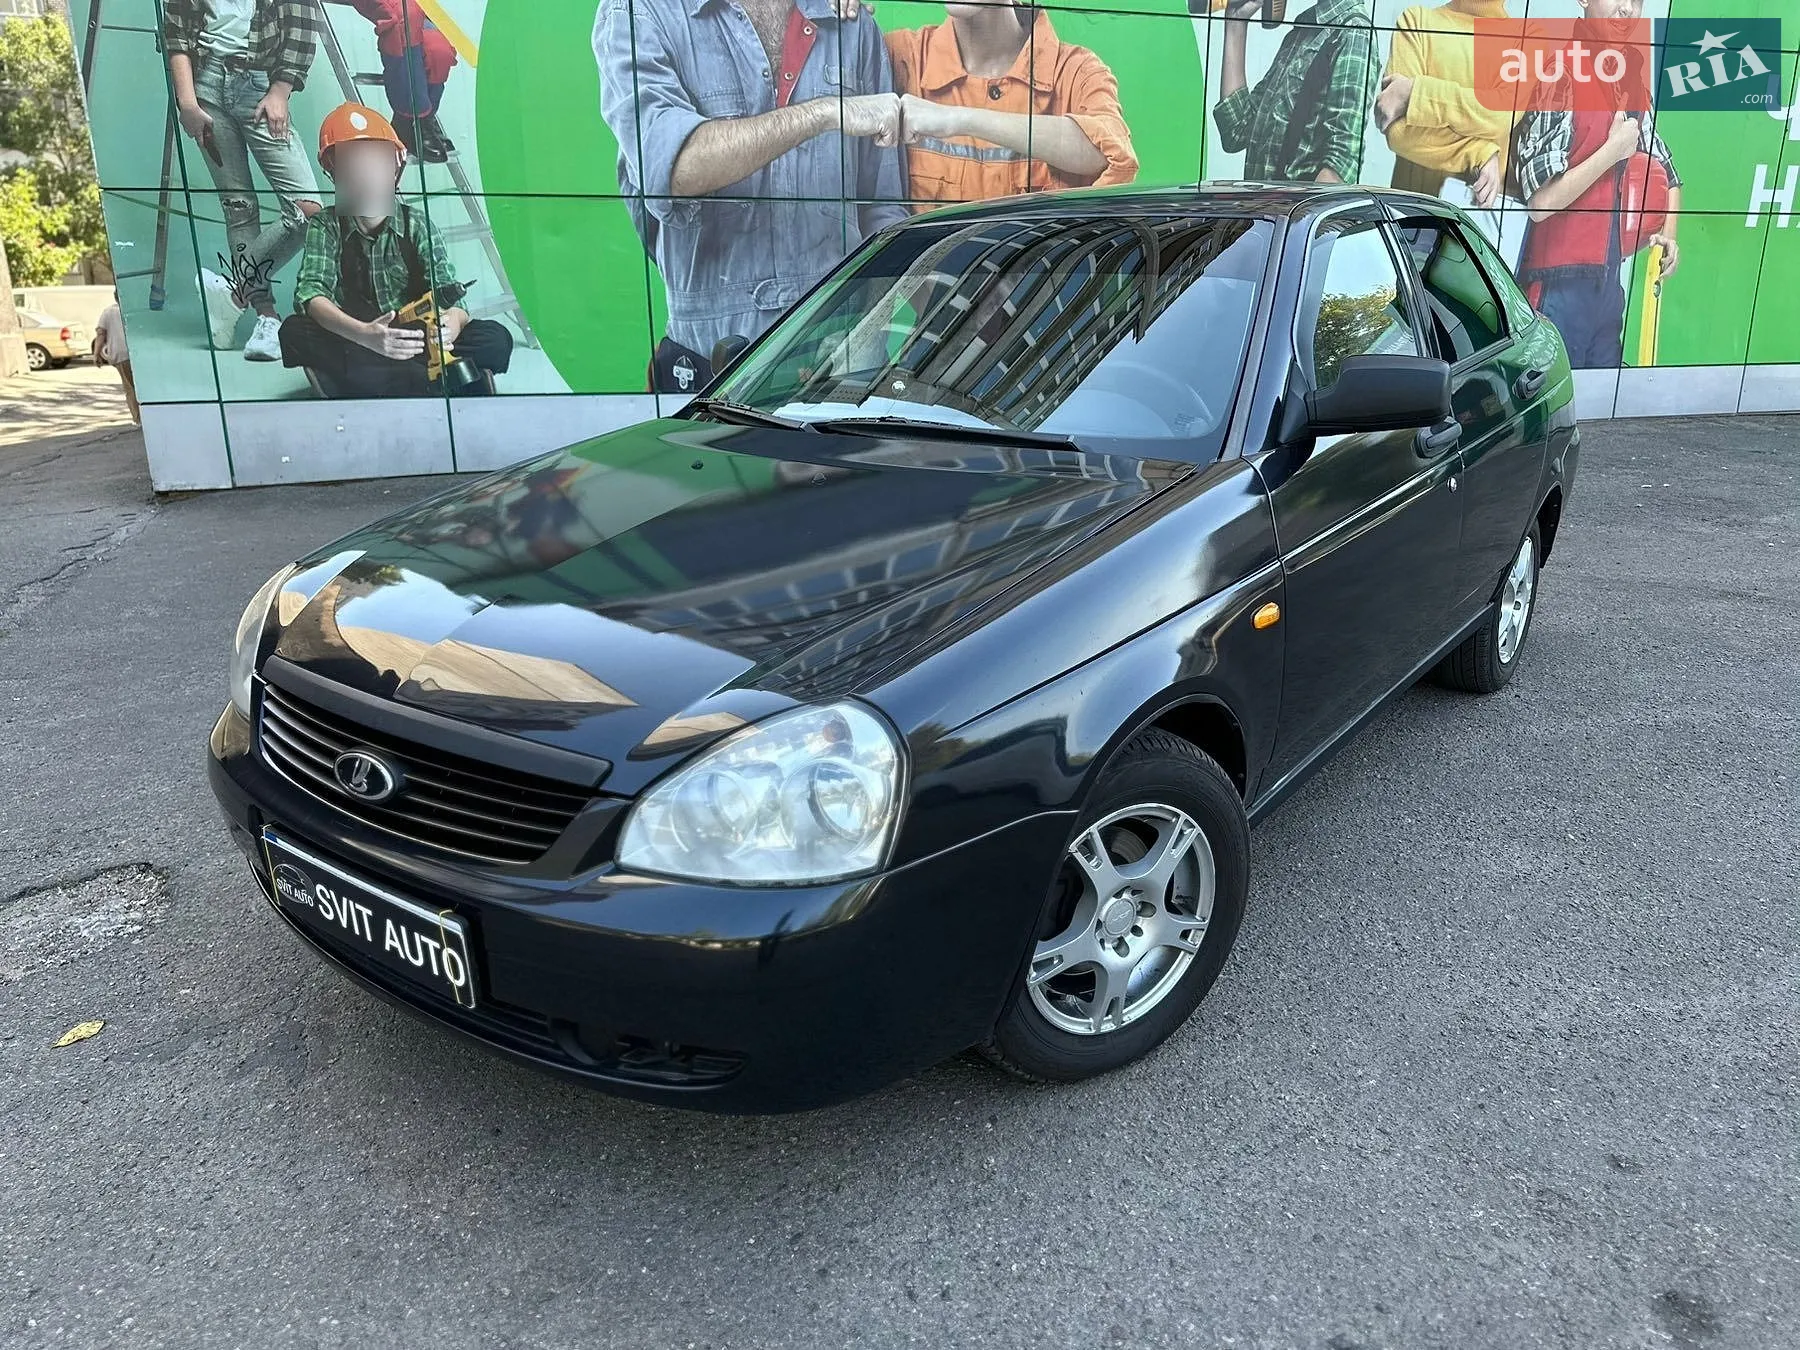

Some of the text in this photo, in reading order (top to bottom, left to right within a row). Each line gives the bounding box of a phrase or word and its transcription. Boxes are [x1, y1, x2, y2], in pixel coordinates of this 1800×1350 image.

[276, 877, 314, 907] SVIT AUTO
[315, 883, 466, 987] SVIT AUTO
